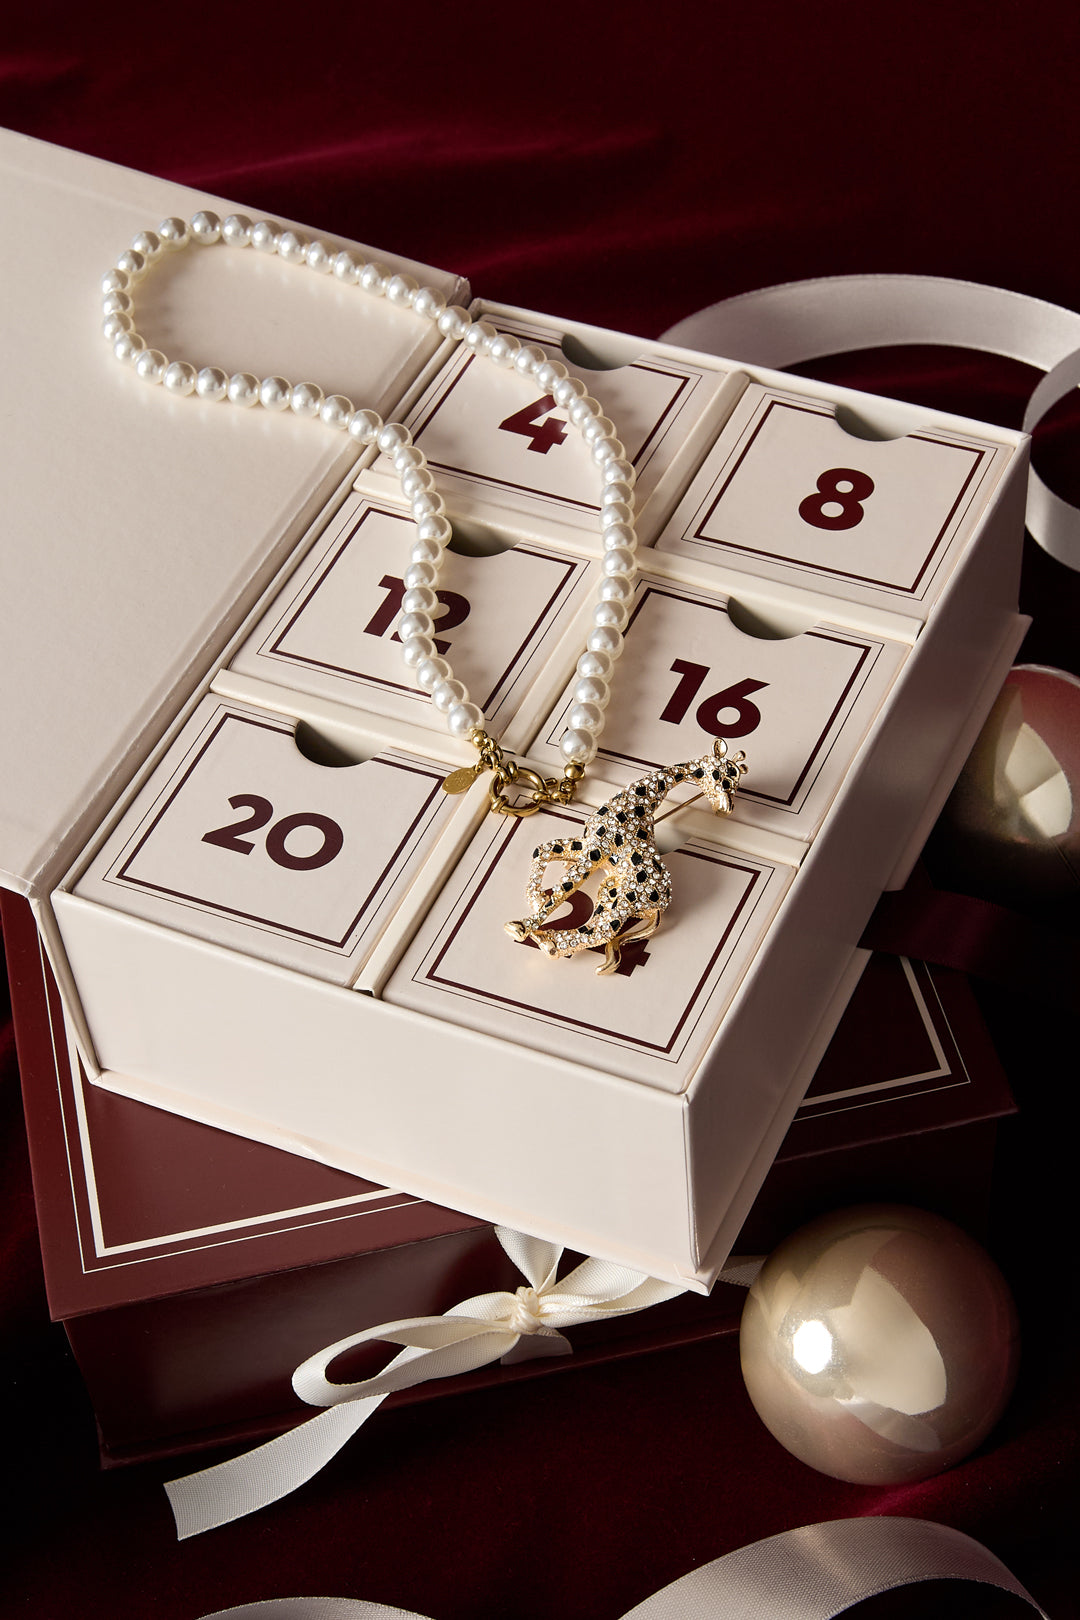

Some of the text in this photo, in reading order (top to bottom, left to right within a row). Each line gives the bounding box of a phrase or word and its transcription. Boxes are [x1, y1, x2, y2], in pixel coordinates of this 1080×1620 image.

[498, 394, 568, 455] 4
[798, 467, 875, 531] 8
[363, 574, 471, 655] 12
[658, 658, 771, 739] 16
[202, 794, 343, 871] 20
